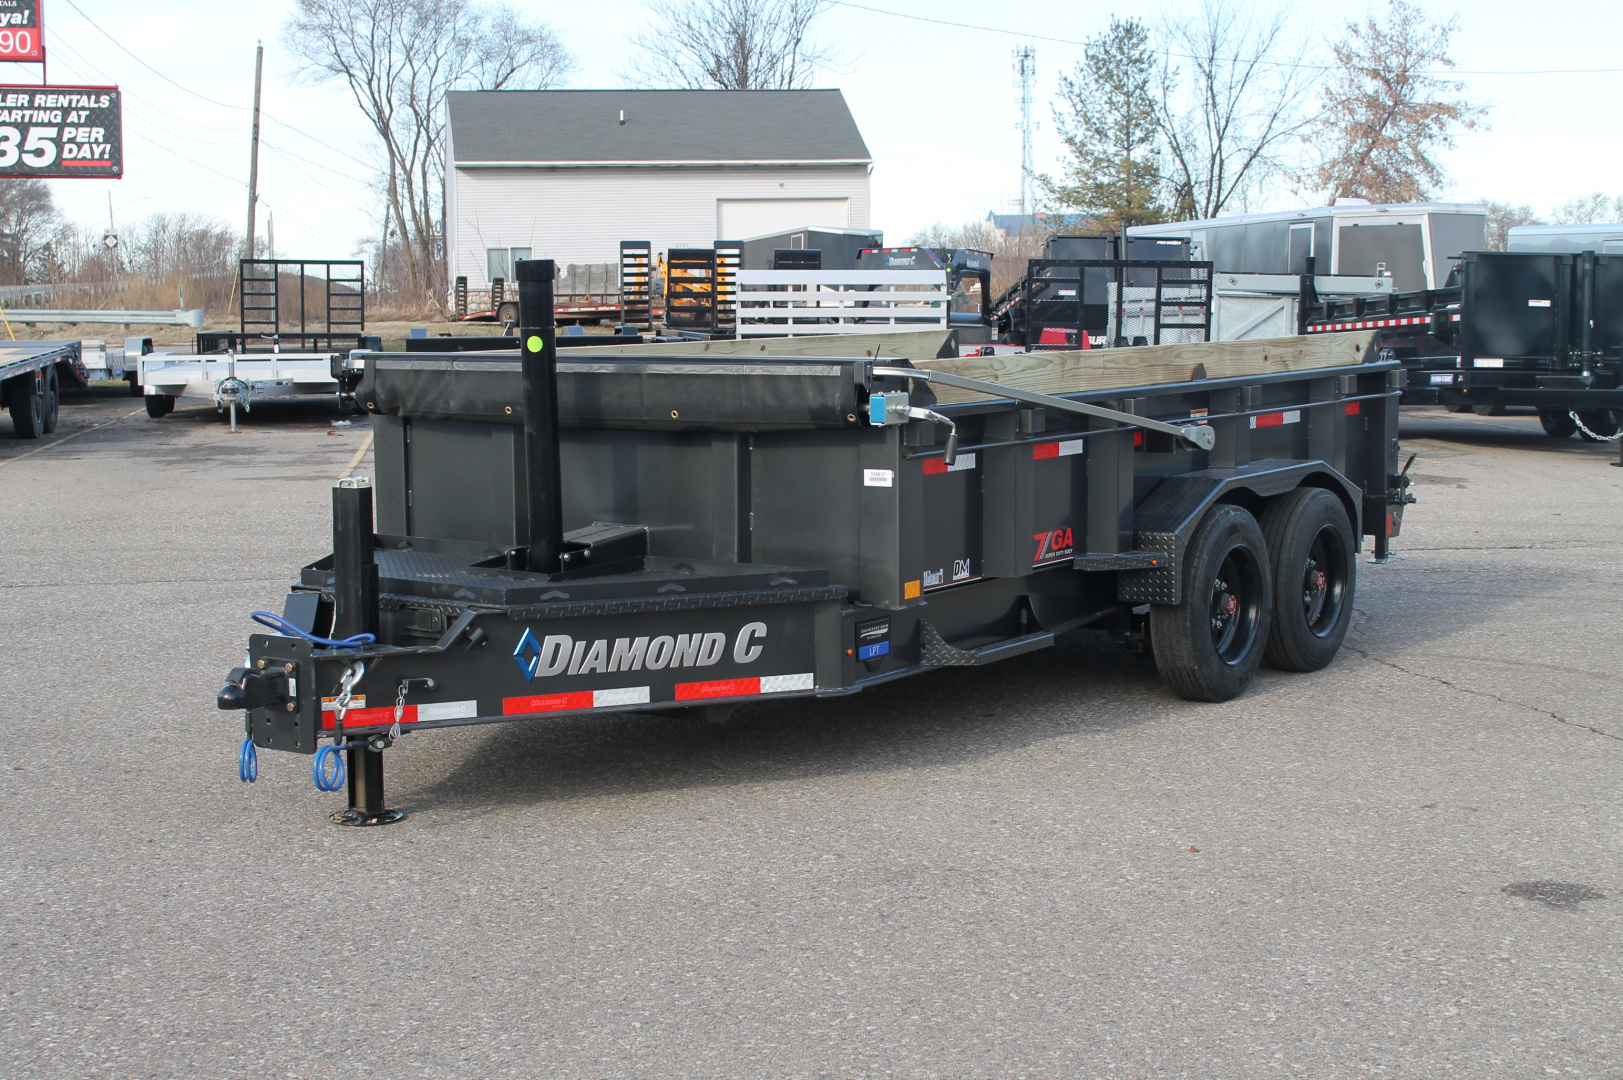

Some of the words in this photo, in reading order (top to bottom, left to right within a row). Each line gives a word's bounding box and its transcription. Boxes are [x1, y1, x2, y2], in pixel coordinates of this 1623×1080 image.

[34, 95, 110, 108] RENTALS
[0, 109, 63, 123] ARTING
[66, 110, 90, 123] AT
[62, 127, 105, 143] PER
[62, 143, 111, 159] DAY!
[534, 631, 727, 678] DIAMOND
[733, 621, 768, 664] C
[869, 645, 880, 656] LPT
[535, 698, 562, 706] DIAMOND
[355, 712, 384, 721] DIAMOND
[433, 706, 460, 715] DIAMOND
[460, 705, 467, 713] C
